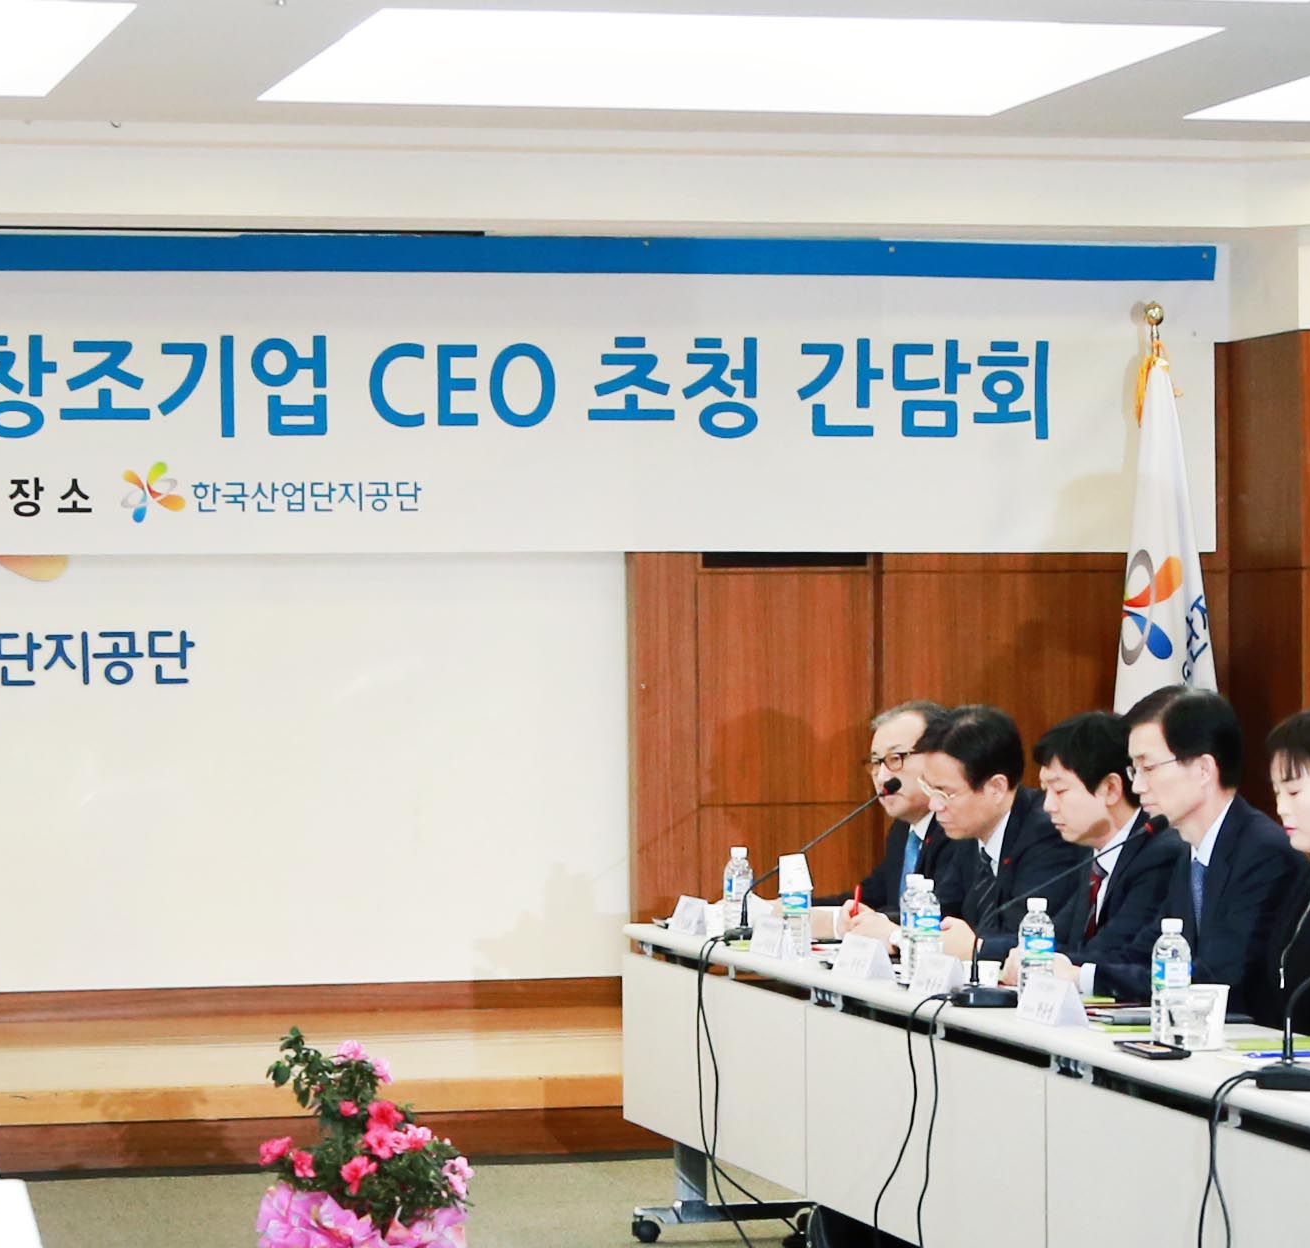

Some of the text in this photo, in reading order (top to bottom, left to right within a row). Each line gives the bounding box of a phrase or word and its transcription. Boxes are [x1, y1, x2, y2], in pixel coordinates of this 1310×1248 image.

[369, 343, 555, 427] CEO
[588, 337, 758, 439] 초청
[797, 338, 1049, 439] 간담회
[191, 480, 422, 513] 한국산업단지공단
